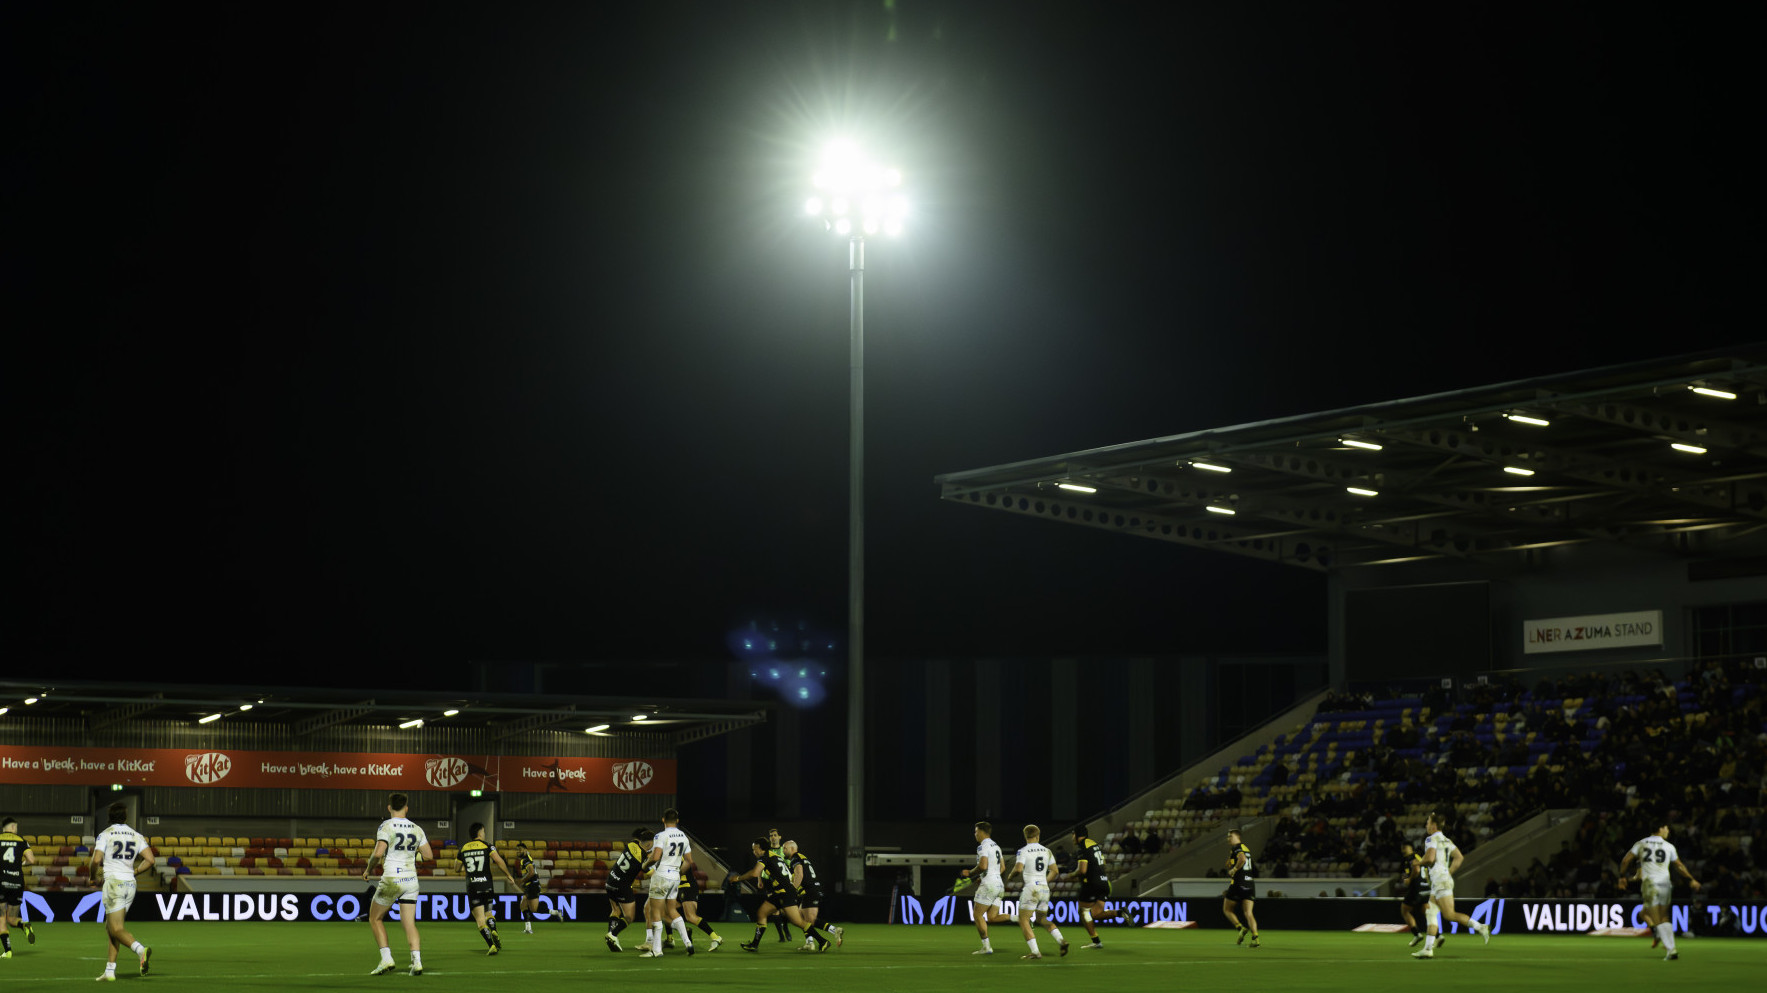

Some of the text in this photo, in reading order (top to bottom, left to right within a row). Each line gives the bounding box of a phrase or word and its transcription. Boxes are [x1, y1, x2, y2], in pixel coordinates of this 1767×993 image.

[1529, 622, 1653, 643] LNER AZUMA STAND
[2, 757, 30, 769] Have
[32, 760, 39, 769] a
[81, 759, 105, 770] have
[108, 762, 115, 770] a
[118, 759, 155, 772] KitKat
[190, 753, 230, 783] KitKat
[261, 762, 288, 774] Have
[289, 765, 296, 774] a
[334, 763, 357, 775] have
[360, 766, 366, 775] a
[368, 764, 403, 776] KitKat
[430, 758, 467, 787] KitKat
[522, 767, 548, 778] Have
[549, 769, 556, 778] a
[617, 762, 652, 790] KitKat
[112, 840, 136, 860] 25
[394, 832, 417, 851] 22
[668, 842, 685, 857] 21
[2, 846, 16, 864] 4
[464, 855, 485, 873] 37
[995, 850, 1001, 865] 9
[1035, 856, 1045, 872] 6
[1643, 847, 1666, 864] 29
[155, 893, 577, 921] VALIDUS COTRUTON
[1523, 903, 1625, 931] VALIDUS
